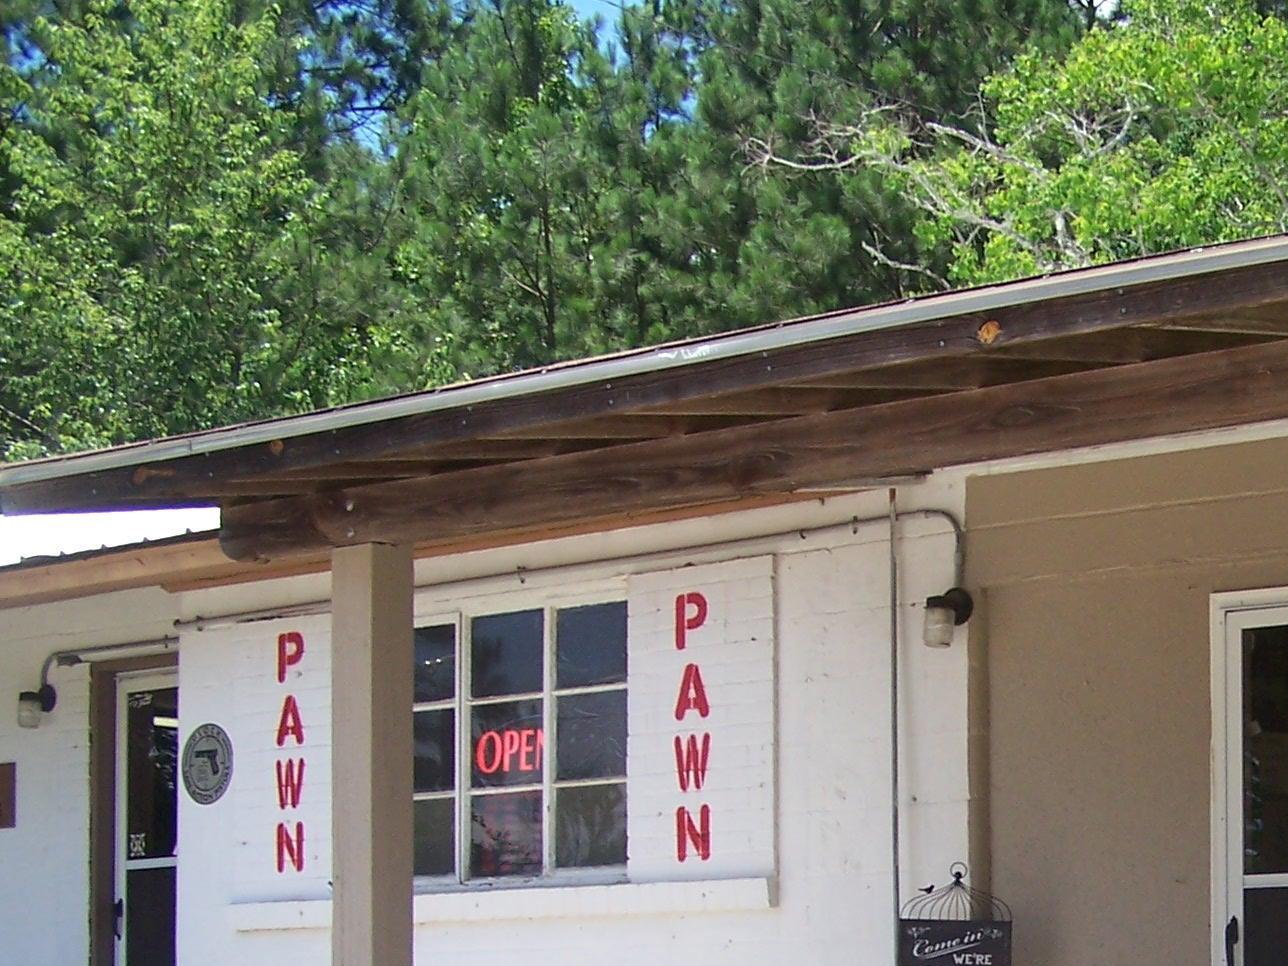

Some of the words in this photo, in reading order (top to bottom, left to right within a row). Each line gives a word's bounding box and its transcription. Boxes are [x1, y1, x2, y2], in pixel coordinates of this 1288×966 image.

[276, 630, 305, 873] PAWN
[673, 591, 711, 863] PAWN
[912, 938, 962, 958] Come
[952, 953, 993, 966] WE'RE
